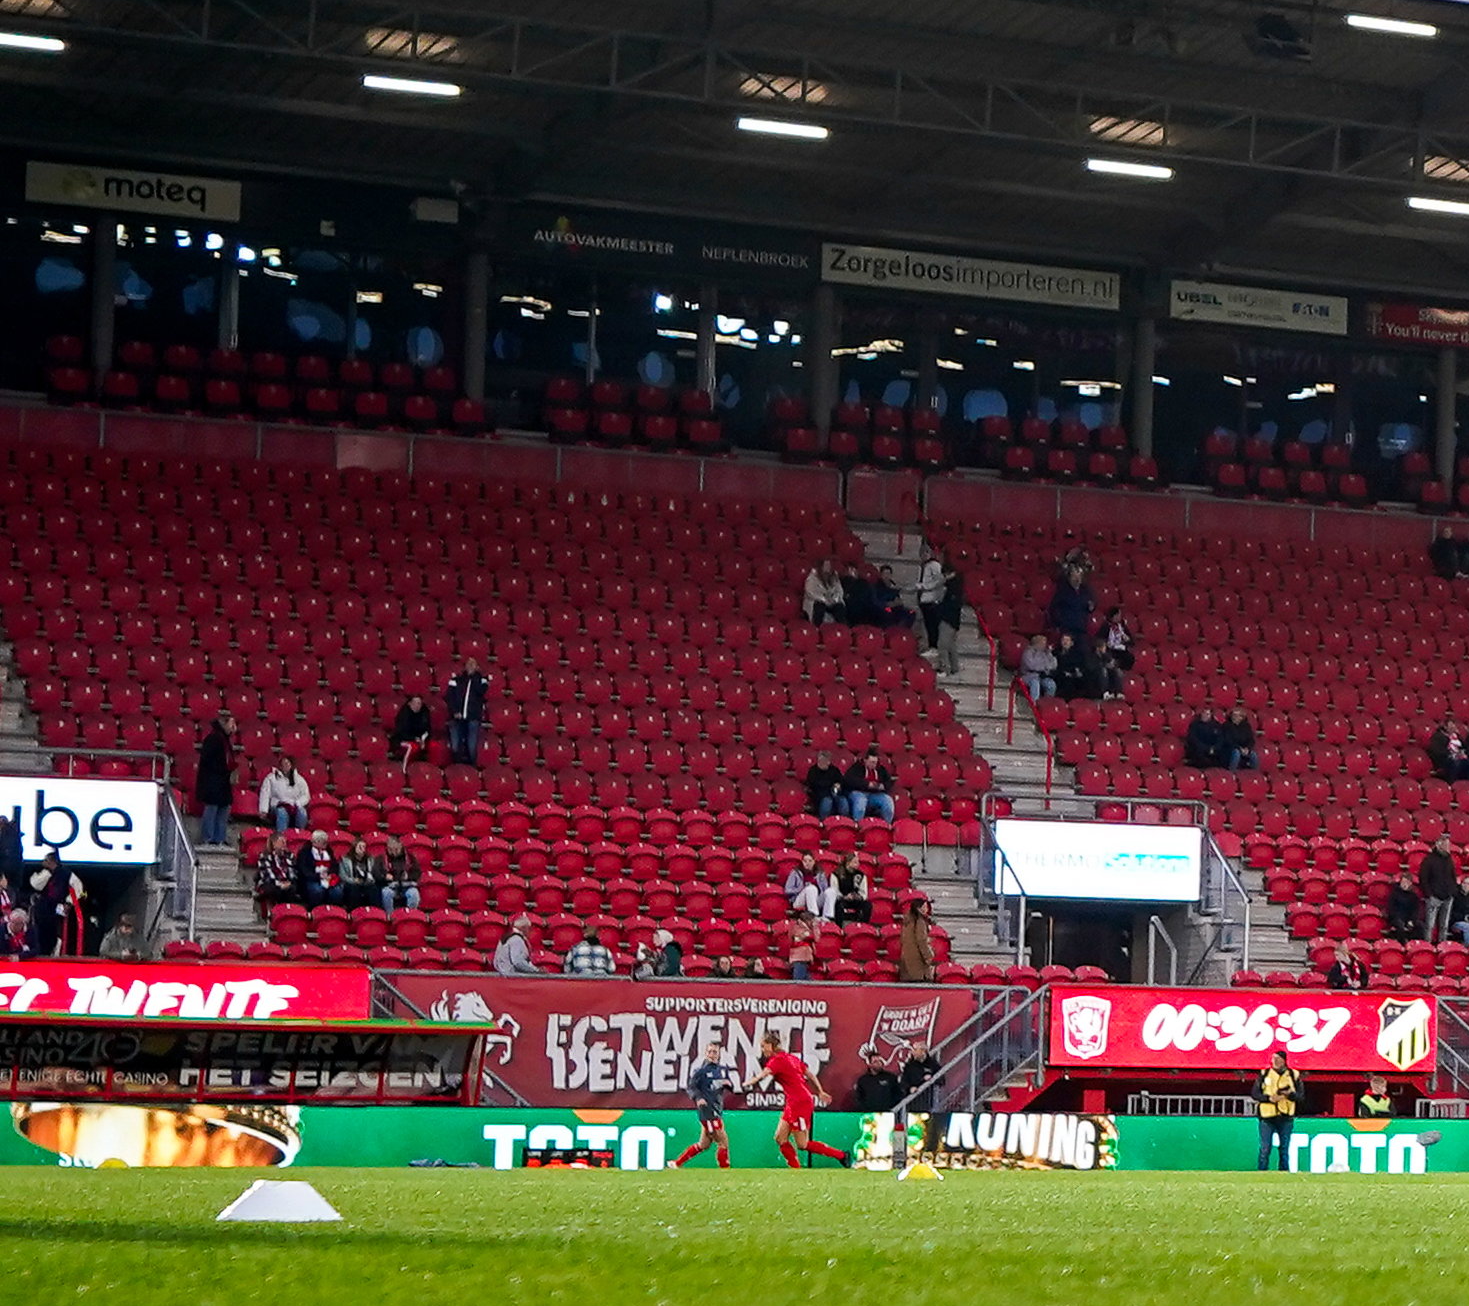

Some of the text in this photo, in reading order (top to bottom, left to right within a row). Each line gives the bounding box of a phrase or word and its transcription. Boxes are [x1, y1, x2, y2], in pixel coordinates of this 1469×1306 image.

[103, 172, 207, 213] moteq
[533, 228, 674, 255] AUTOVAKMEESTER
[830, 248, 1114, 300] Zorgeloosimporteren.nl
[1386, 321, 1421, 339] You'll
[1423, 330, 1458, 343] never
[645, 996, 827, 1015] SUPPORTERSVERENIGING
[609, 1012, 831, 1061] TWENTE
[1142, 1003, 1352, 1053] 00:36:37
[185, 1031, 338, 1055] SPELER
[113, 1069, 169, 1085] CASINO
[180, 1058, 442, 1087] HET SEIZOEN
[746, 1093, 785, 1107] SINDS
[482, 1123, 667, 1171] TOTO
[1272, 1131, 1427, 1174] TOTO
